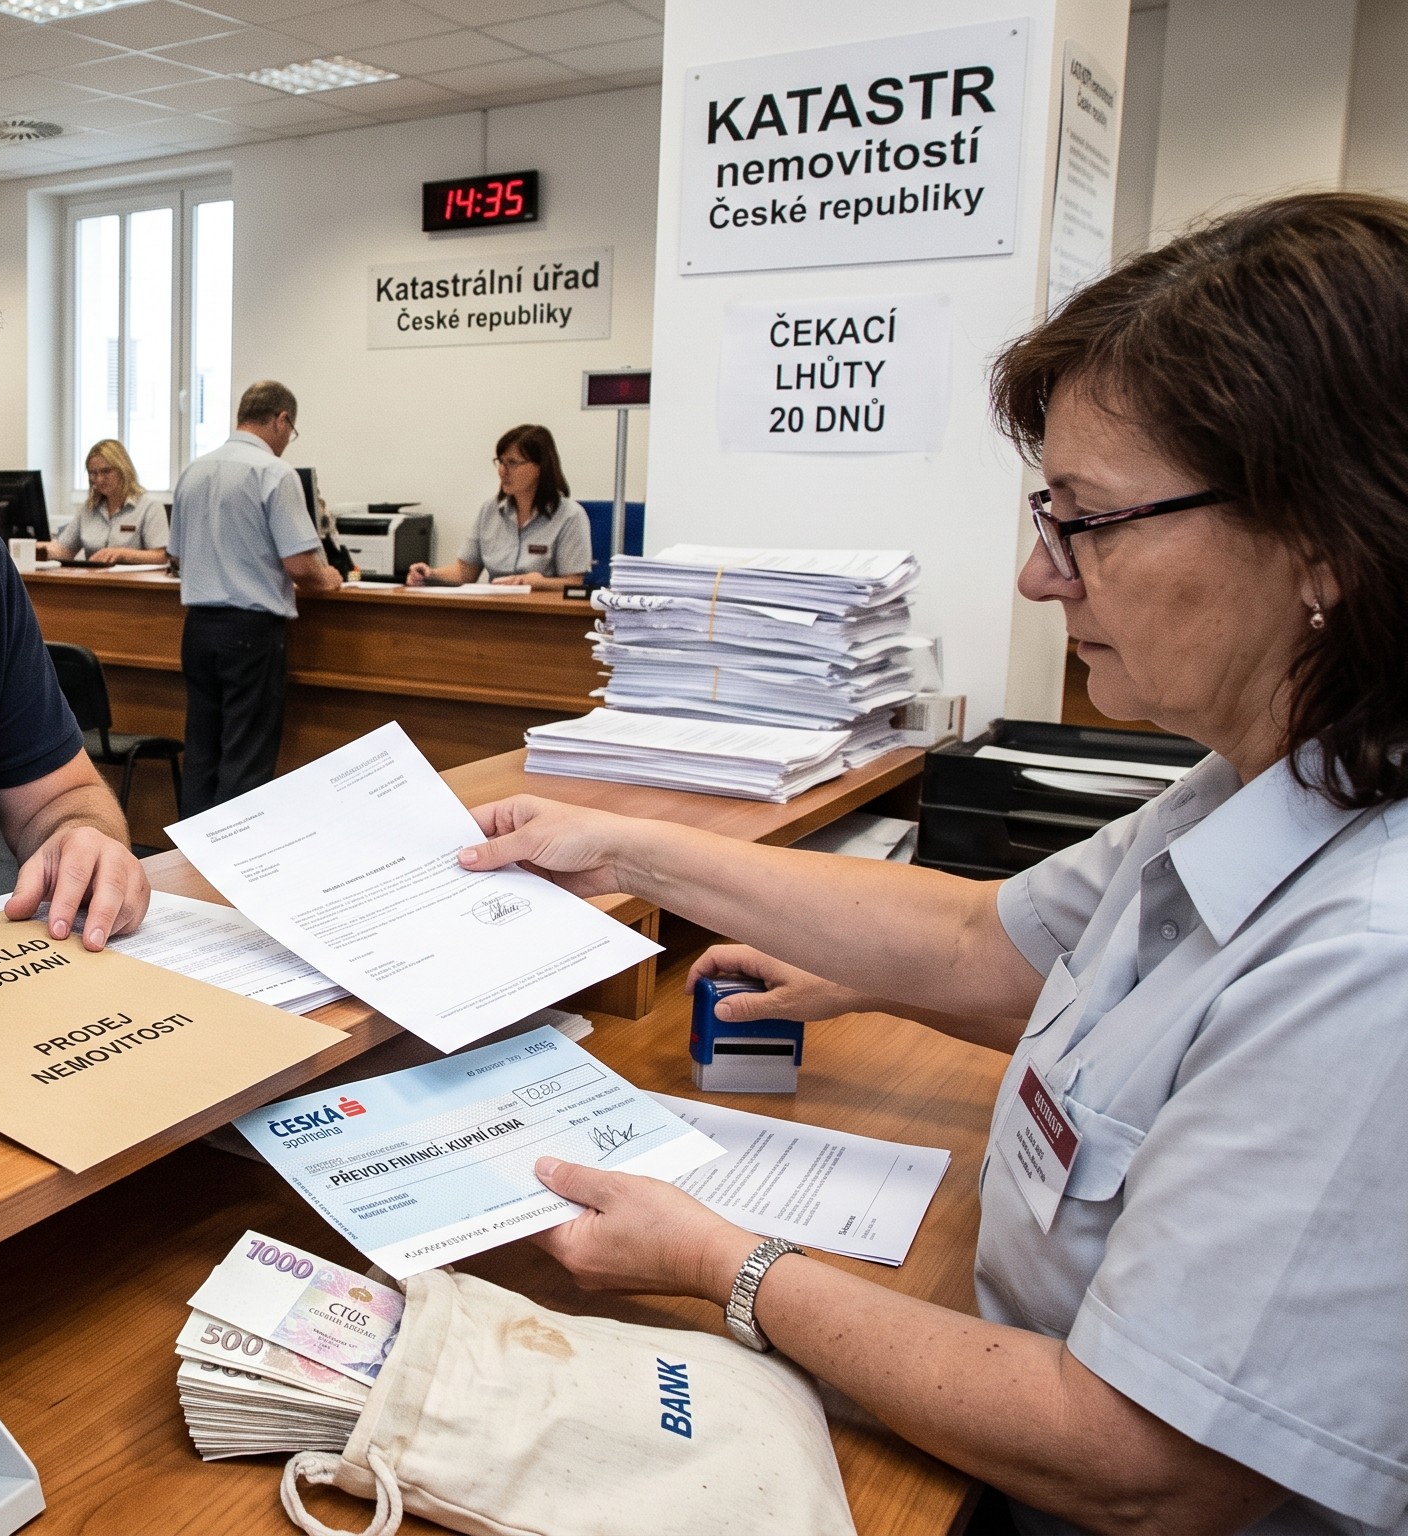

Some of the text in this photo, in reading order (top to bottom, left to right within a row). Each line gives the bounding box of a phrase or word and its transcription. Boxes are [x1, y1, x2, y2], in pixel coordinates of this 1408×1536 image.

[707, 65, 995, 144] KATASTR
[717, 125, 981, 187] nemovitostí
[445, 179, 522, 219] 14:35
[709, 182, 984, 229] České republiky
[376, 260, 599, 301] Katastrální úřad
[397, 302, 572, 331] České republiky
[770, 307, 896, 347] ČEKACÍ
[776, 355, 885, 389] LHŮTY
[769, 398, 884, 432] 20 DNŮ
[31, 1013, 193, 1084] NEMOVITOSTI
[33, 1013, 132, 1055] PRODEJ
[445, 1126, 490, 1152] KUPNÍ
[246, 1239, 314, 1280] 1000
[200, 1322, 265, 1355] 500
[656, 1357, 691, 1438] BANK
